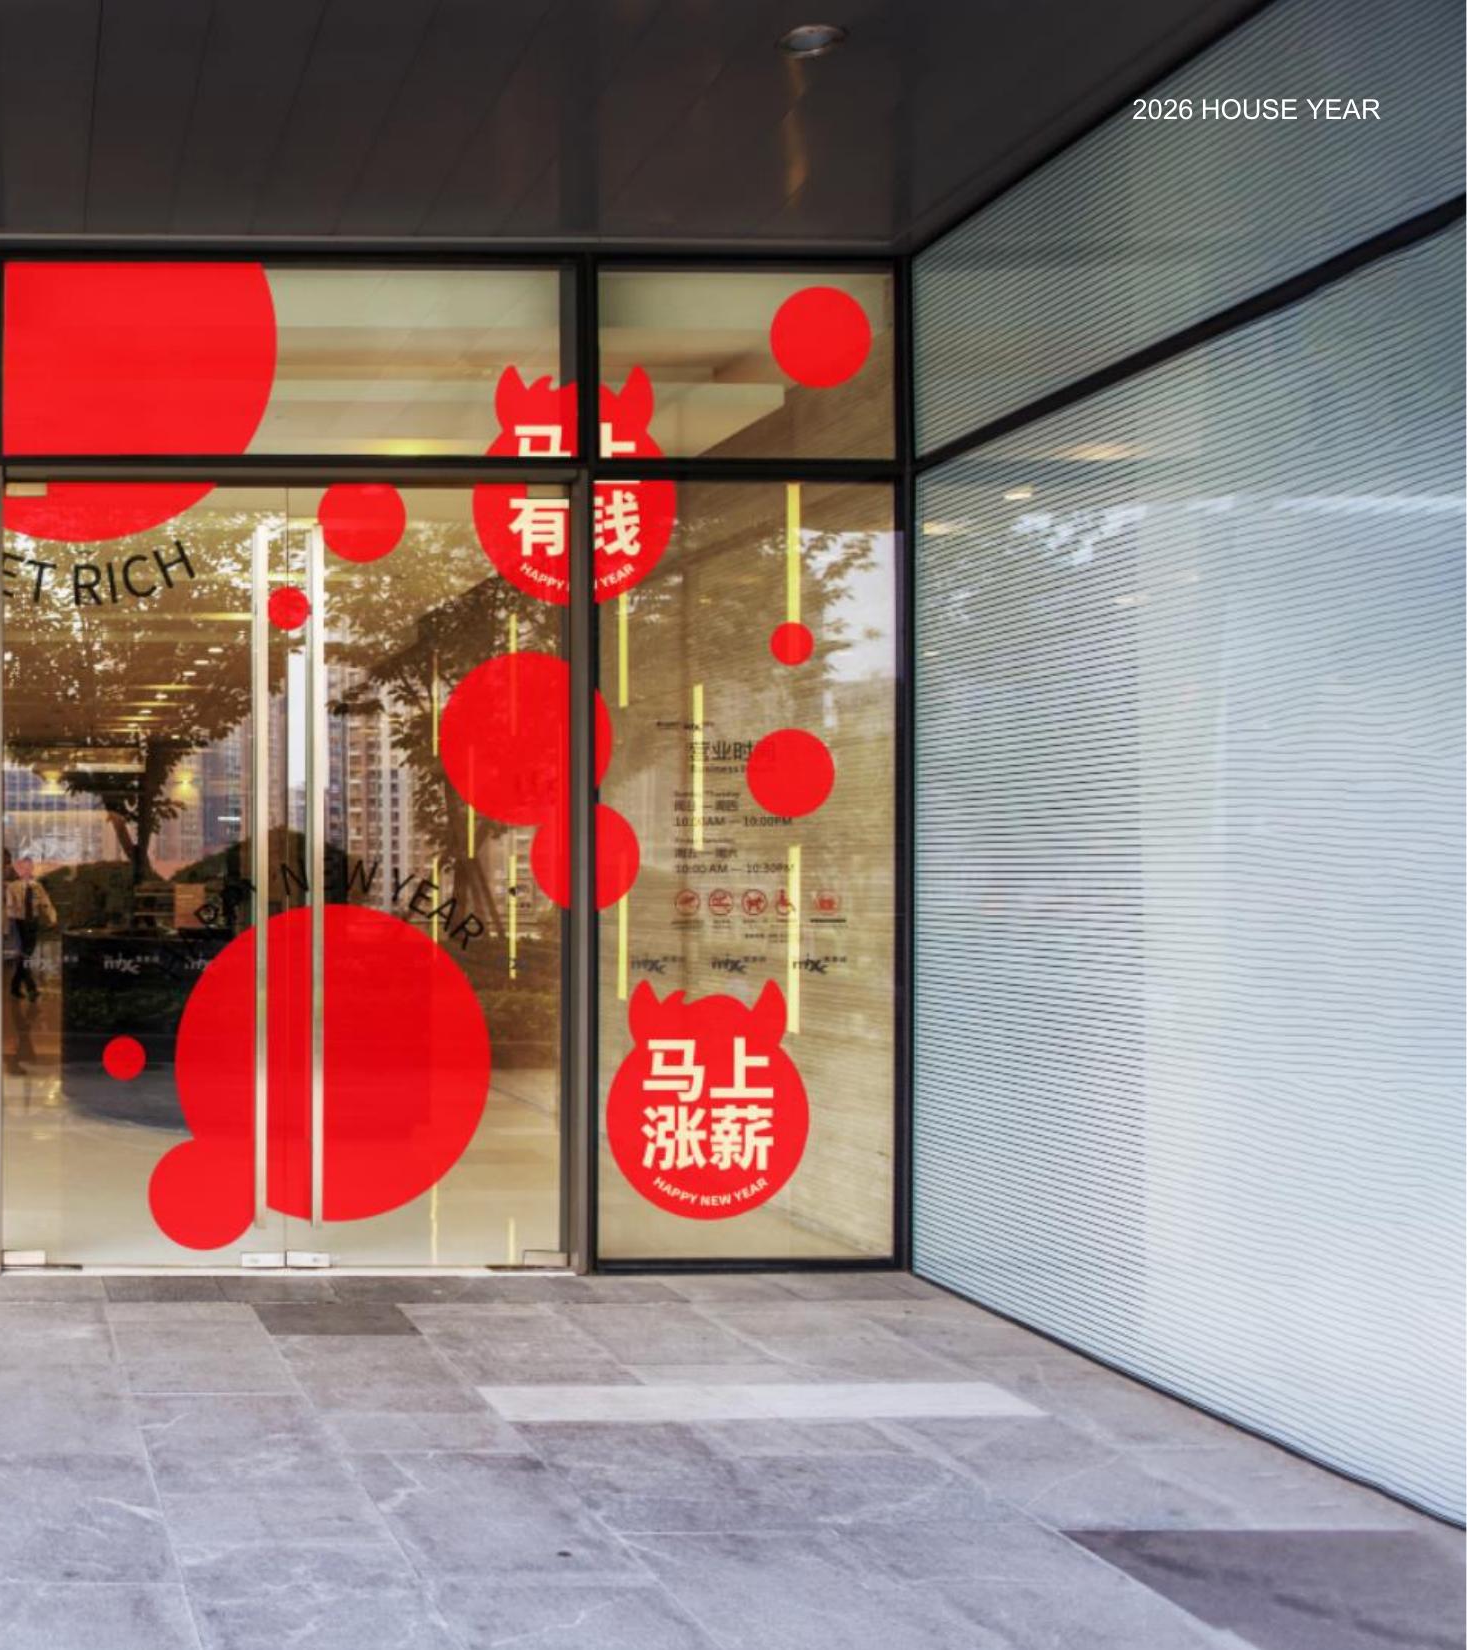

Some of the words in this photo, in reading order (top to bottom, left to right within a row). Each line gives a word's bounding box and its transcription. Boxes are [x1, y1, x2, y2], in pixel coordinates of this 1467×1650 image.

[508, 489, 641, 556] 有钱
[73, 539, 196, 606] RICH
[520, 561, 565, 590] HAPPY
[600, 563, 636, 588] YEAR
[689, 740, 775, 761] 营业时
[391, 867, 484, 950] YEAR
[642, 1036, 775, 1103] 马上
[640, 1103, 775, 1172] 涨薪
[652, 1175, 698, 1203] HAPPY
[700, 1192, 731, 1207] NEW
[734, 1176, 769, 1201] YEAR
